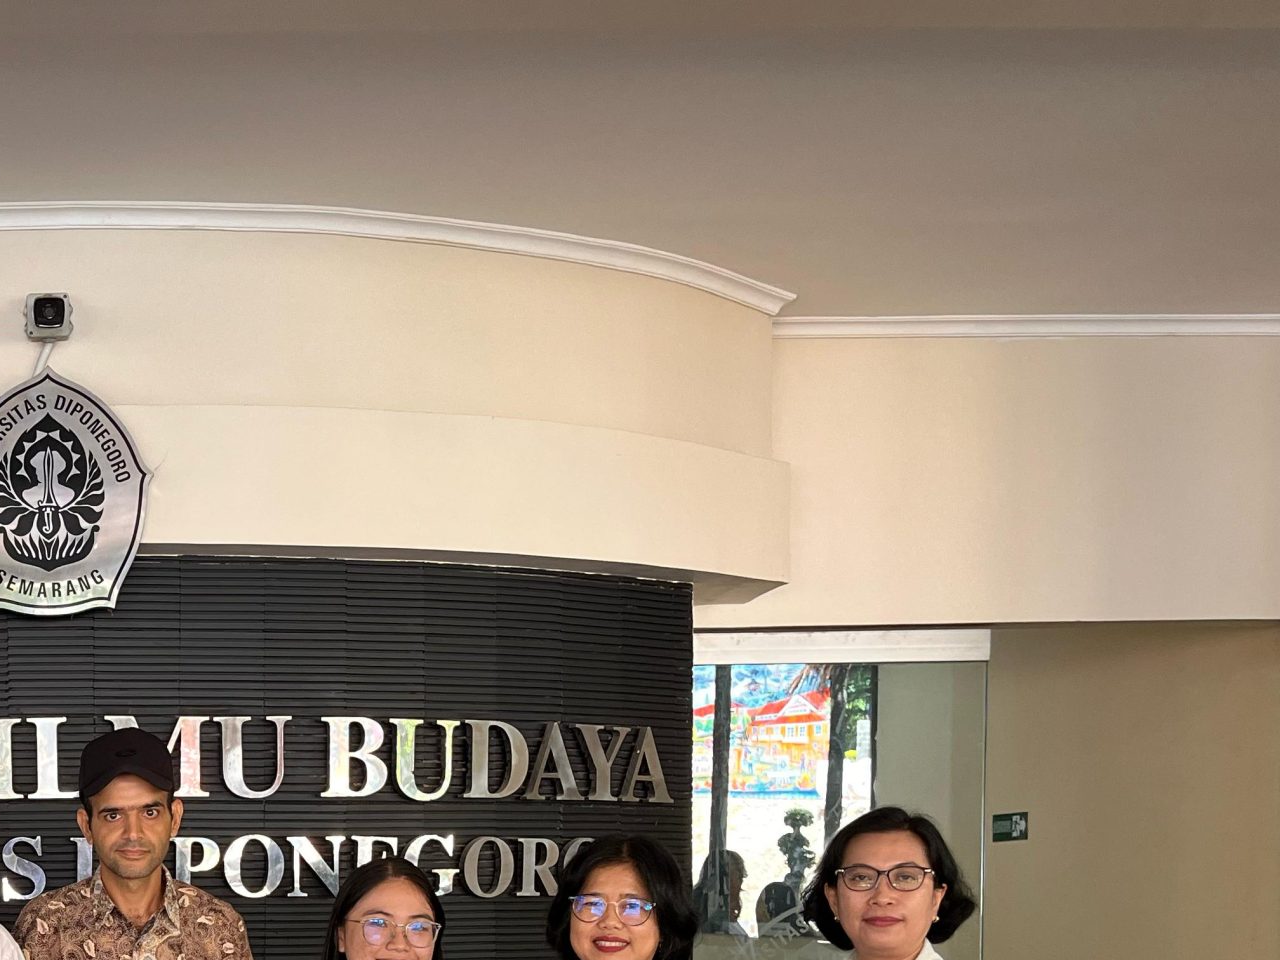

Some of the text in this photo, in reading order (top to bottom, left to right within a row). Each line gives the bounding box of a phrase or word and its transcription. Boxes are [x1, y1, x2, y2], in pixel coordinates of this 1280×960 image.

[54, 394, 131, 483] DIPONEGORO
[320, 716, 674, 805] BUDAYA
[69, 833, 596, 899] PONGOR
